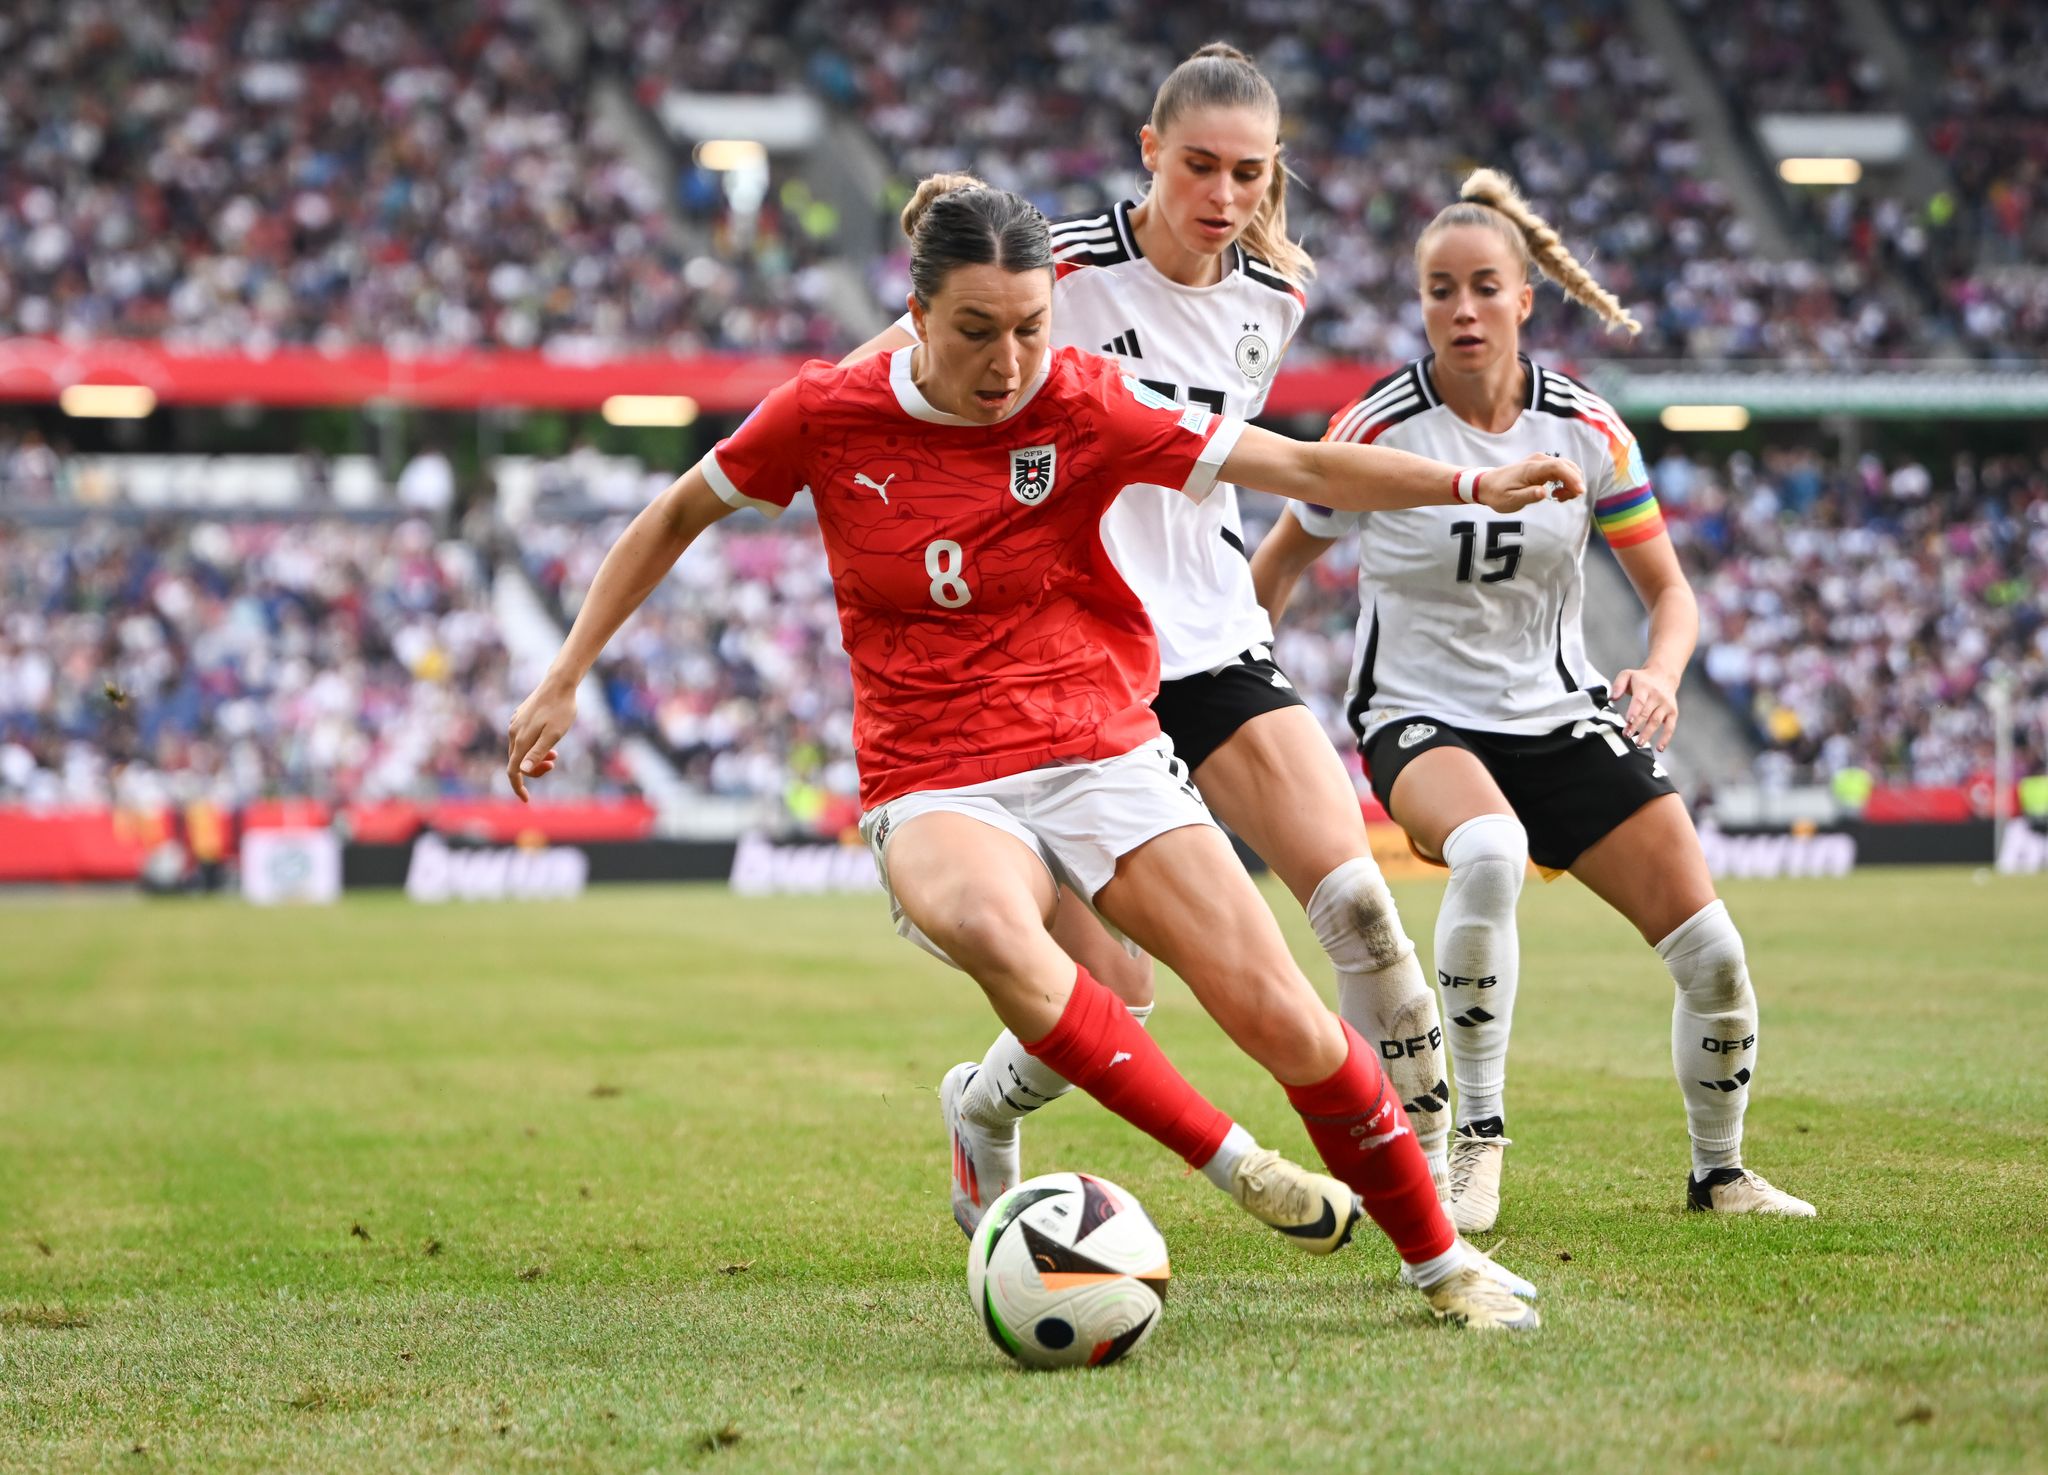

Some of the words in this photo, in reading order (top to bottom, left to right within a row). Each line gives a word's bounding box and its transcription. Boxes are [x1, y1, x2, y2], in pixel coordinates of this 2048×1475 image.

[1450, 520, 1524, 584] 15
[925, 539, 972, 608] 8
[1438, 969, 1497, 989] DFB
[1380, 1026, 1441, 1059] DFB
[1702, 1034, 1755, 1055] DFB
